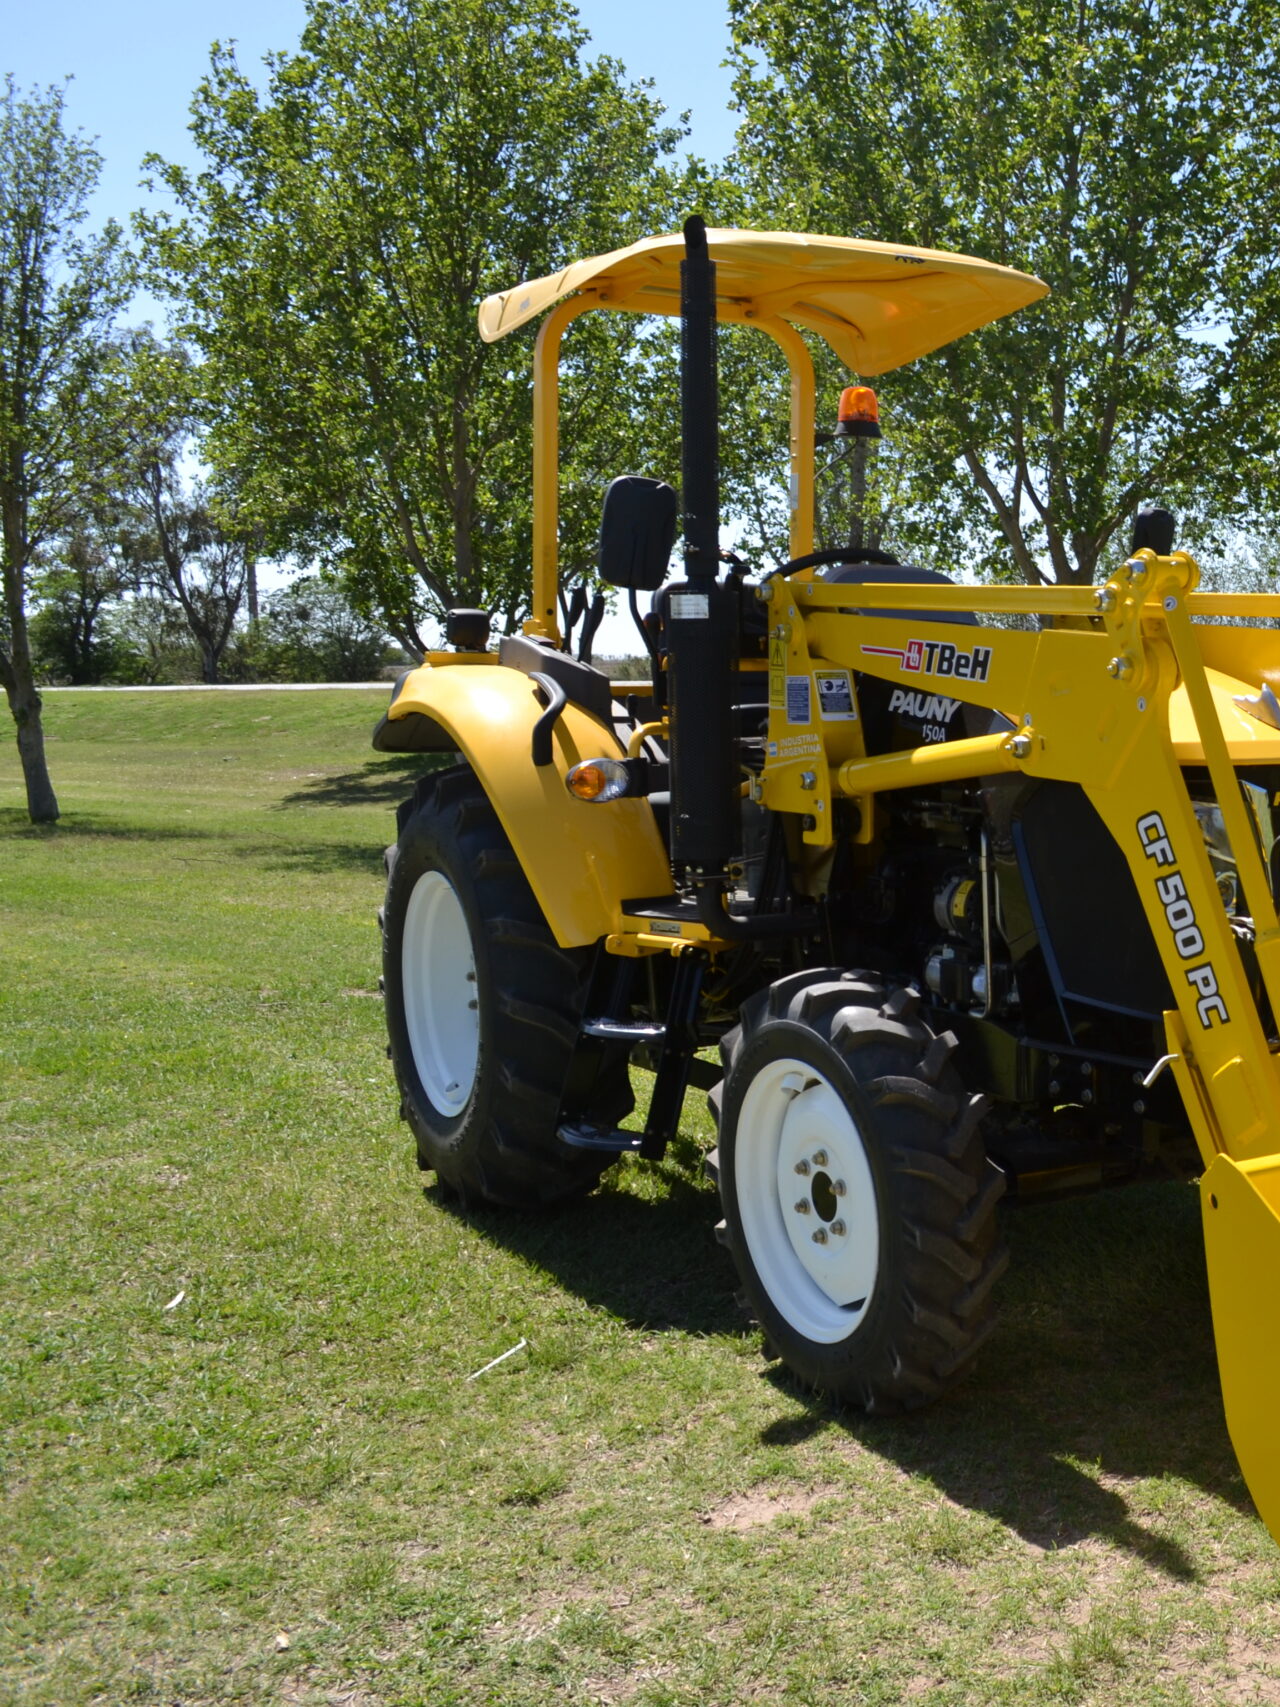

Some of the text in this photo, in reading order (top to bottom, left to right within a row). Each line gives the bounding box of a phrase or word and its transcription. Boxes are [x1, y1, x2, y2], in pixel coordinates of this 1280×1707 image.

[888, 689, 963, 723] PAUNY
[780, 733, 819, 747] INDUSTRIA
[922, 723, 946, 742] 150A
[779, 744, 821, 757] ARGENTINA
[1137, 811, 1231, 1030] CF 500 PC
